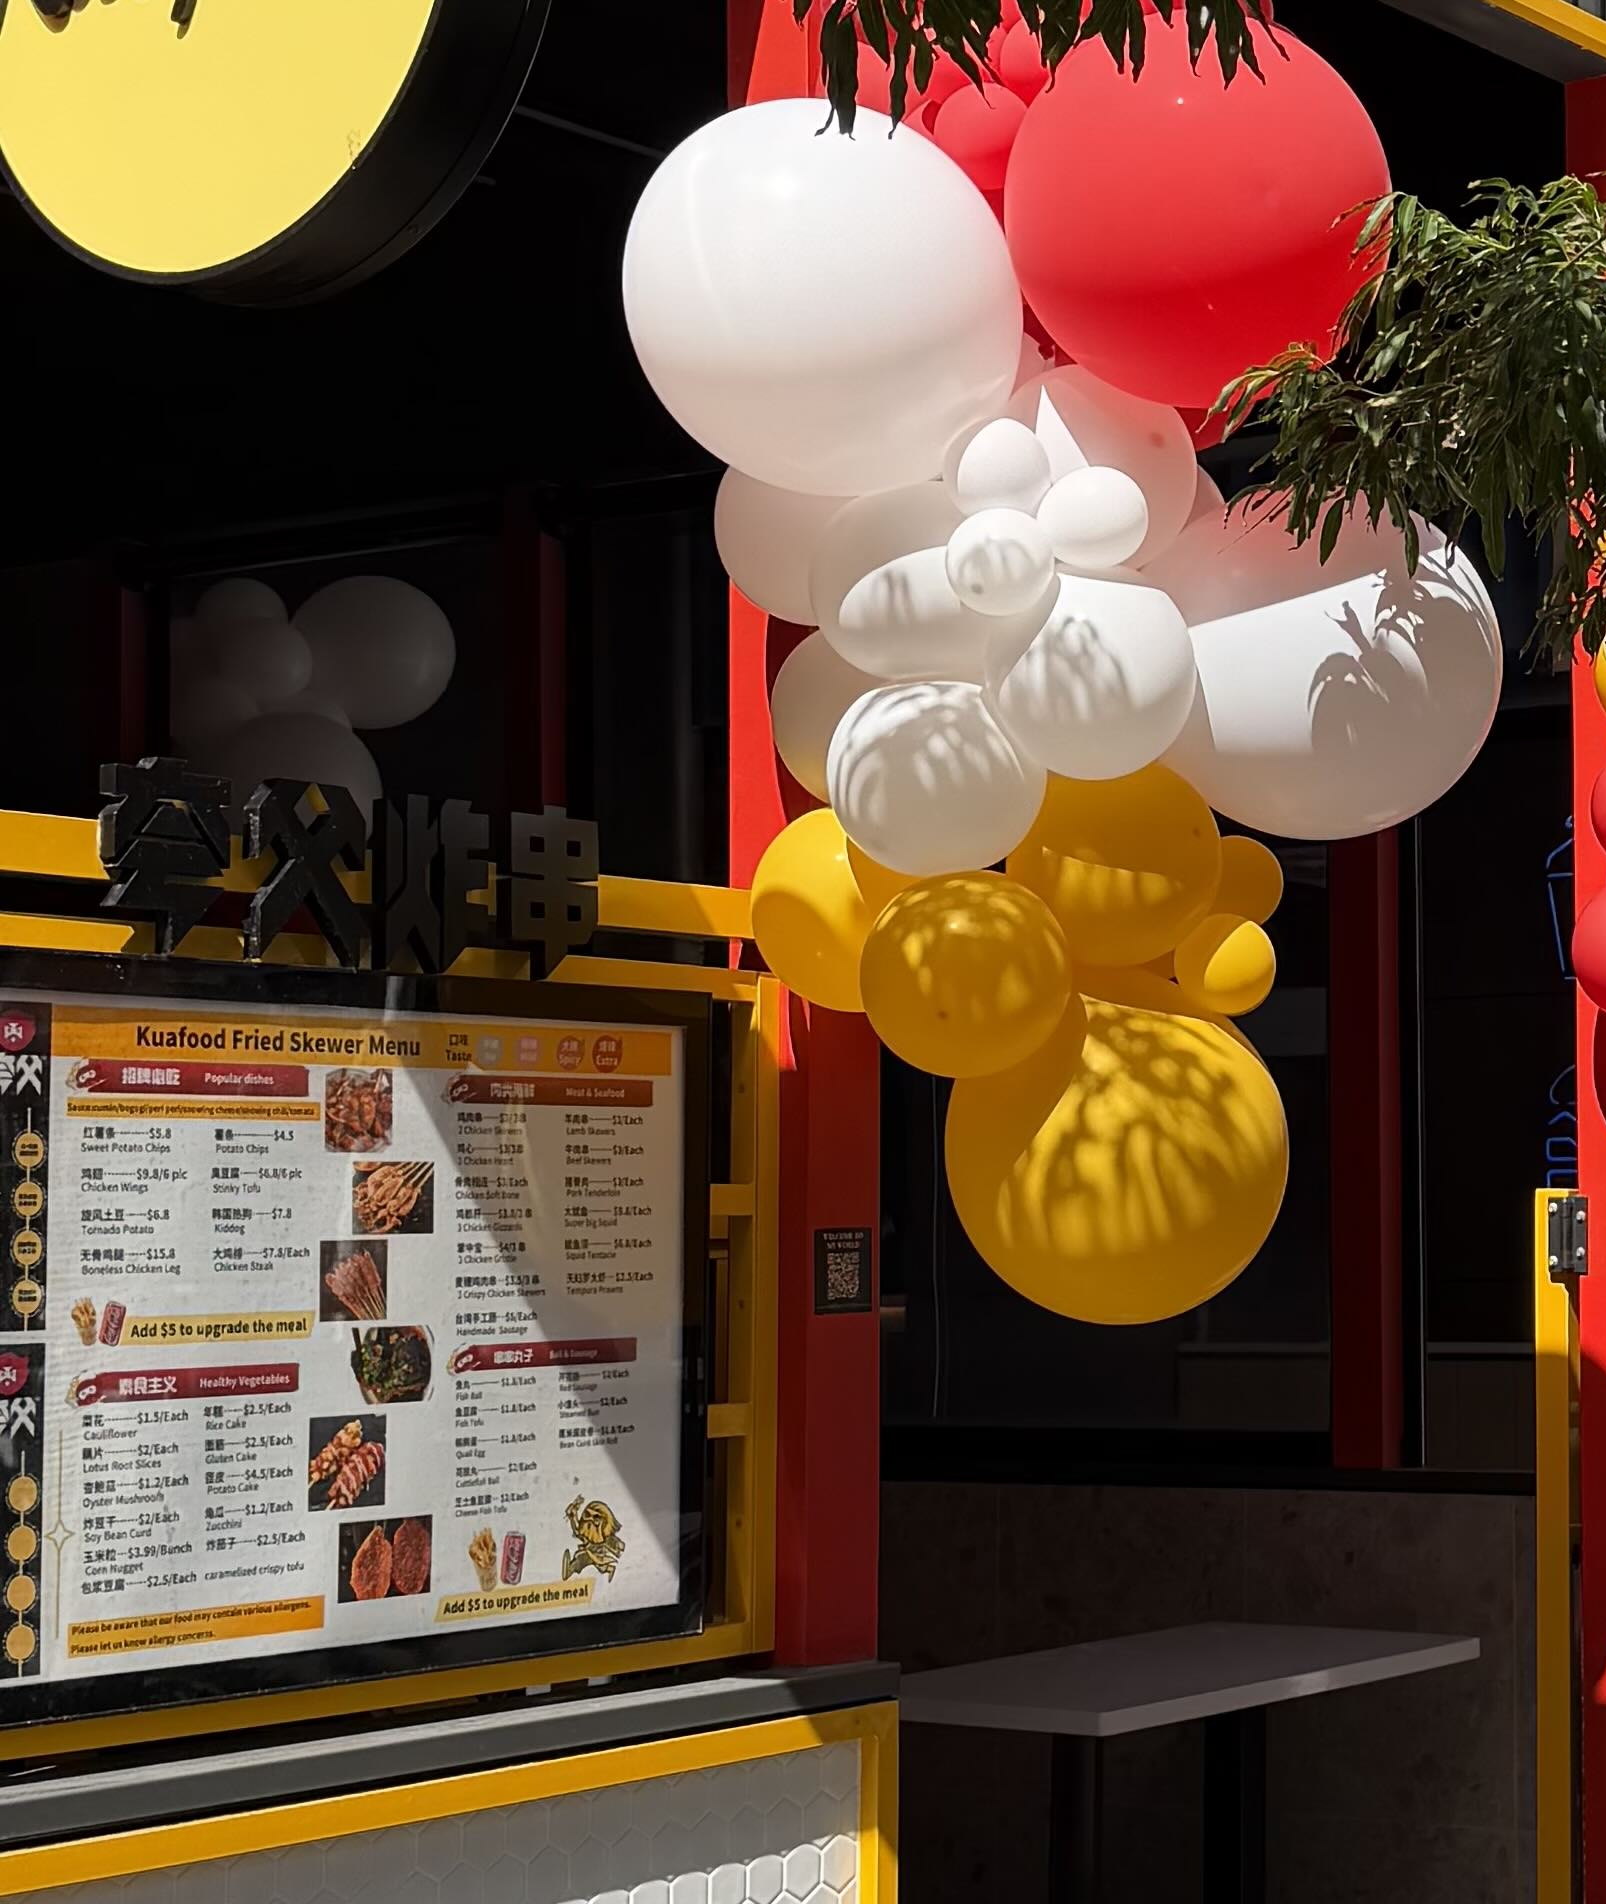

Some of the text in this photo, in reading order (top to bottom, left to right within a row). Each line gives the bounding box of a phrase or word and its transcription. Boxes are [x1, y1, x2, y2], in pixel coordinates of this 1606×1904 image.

[98, 756, 600, 982] 夸父炸串
[137, 1026, 421, 1055] Kuafood Fried Skewer Menu
[445, 1050, 472, 1062] Taste
[204, 1072, 274, 1087] Popular dishes
[149, 1127, 172, 1140] $5.8
[274, 1129, 294, 1141] $4.5
[80, 1142, 171, 1155] Sweet Potato Chips
[215, 1144, 269, 1156] Potato Chips
[136, 1168, 170, 1181] $9.8/6
[81, 1182, 149, 1195] Chicken Wings
[212, 1183, 261, 1196] Stinky Tofu
[81, 1208, 170, 1222] 旋风土豆 $6.8
[271, 1208, 292, 1220] $7.8
[81, 1224, 154, 1235] Tornado Potato
[146, 1249, 175, 1261] $15.8
[81, 1263, 181, 1276] Boneless Chicken Leg
[214, 1261, 249, 1273] Chicken
[130, 1317, 307, 1338] Add $5 to upgrade the meal
[199, 1374, 290, 1389] Healthy Vegetables
[243, 1402, 292, 1415] $2.5/Each
[137, 1411, 189, 1424] $1.5/Each
[206, 1419, 247, 1431] Rice Cake
[83, 1428, 138, 1440] Cauliflower
[244, 1435, 293, 1448] $2.5/Each
[137, 1444, 179, 1456] $2/Each
[205, 1452, 257, 1464] Gluten Cake
[82, 1459, 162, 1473] Lotus Root Slices
[244, 1467, 293, 1481] $4.5/Each
[138, 1474, 189, 1490] $1.2/Each
[207, 1482, 259, 1495] Potato Cake
[82, 1497, 114, 1509] Oyster
[244, 1501, 293, 1516] $1.2/Each
[137, 1512, 180, 1526] $2/Each
[206, 1518, 242, 1531] Zucchini
[84, 1528, 152, 1544] Soy Bean Curd
[256, 1531, 306, 1546] $2.5/Each
[127, 1543, 192, 1559] $3.99/Bunch
[110, 1562, 144, 1575] Nugget
[204, 1561, 305, 1580] caramelized crispy tofu
[146, 1572, 197, 1588] $2.5/Each
[443, 1585, 589, 1615] Add $5 to upgrade the meal
[71, 1623, 100, 1635] Please
[101, 1622, 112, 1632] be
[114, 1620, 139, 1631] aware
[140, 1617, 158, 1628] that
[159, 1617, 173, 1626] our
[174, 1614, 192, 1624] food
[194, 1612, 211, 1623] may
[212, 1608, 242, 1620] contain
[243, 1605, 272, 1616] various
[70, 1643, 99, 1655] Please
[100, 1640, 112, 1651] let
[113, 1641, 123, 1650] us
[123, 1637, 147, 1649] know
[148, 1633, 176, 1646] allergy
